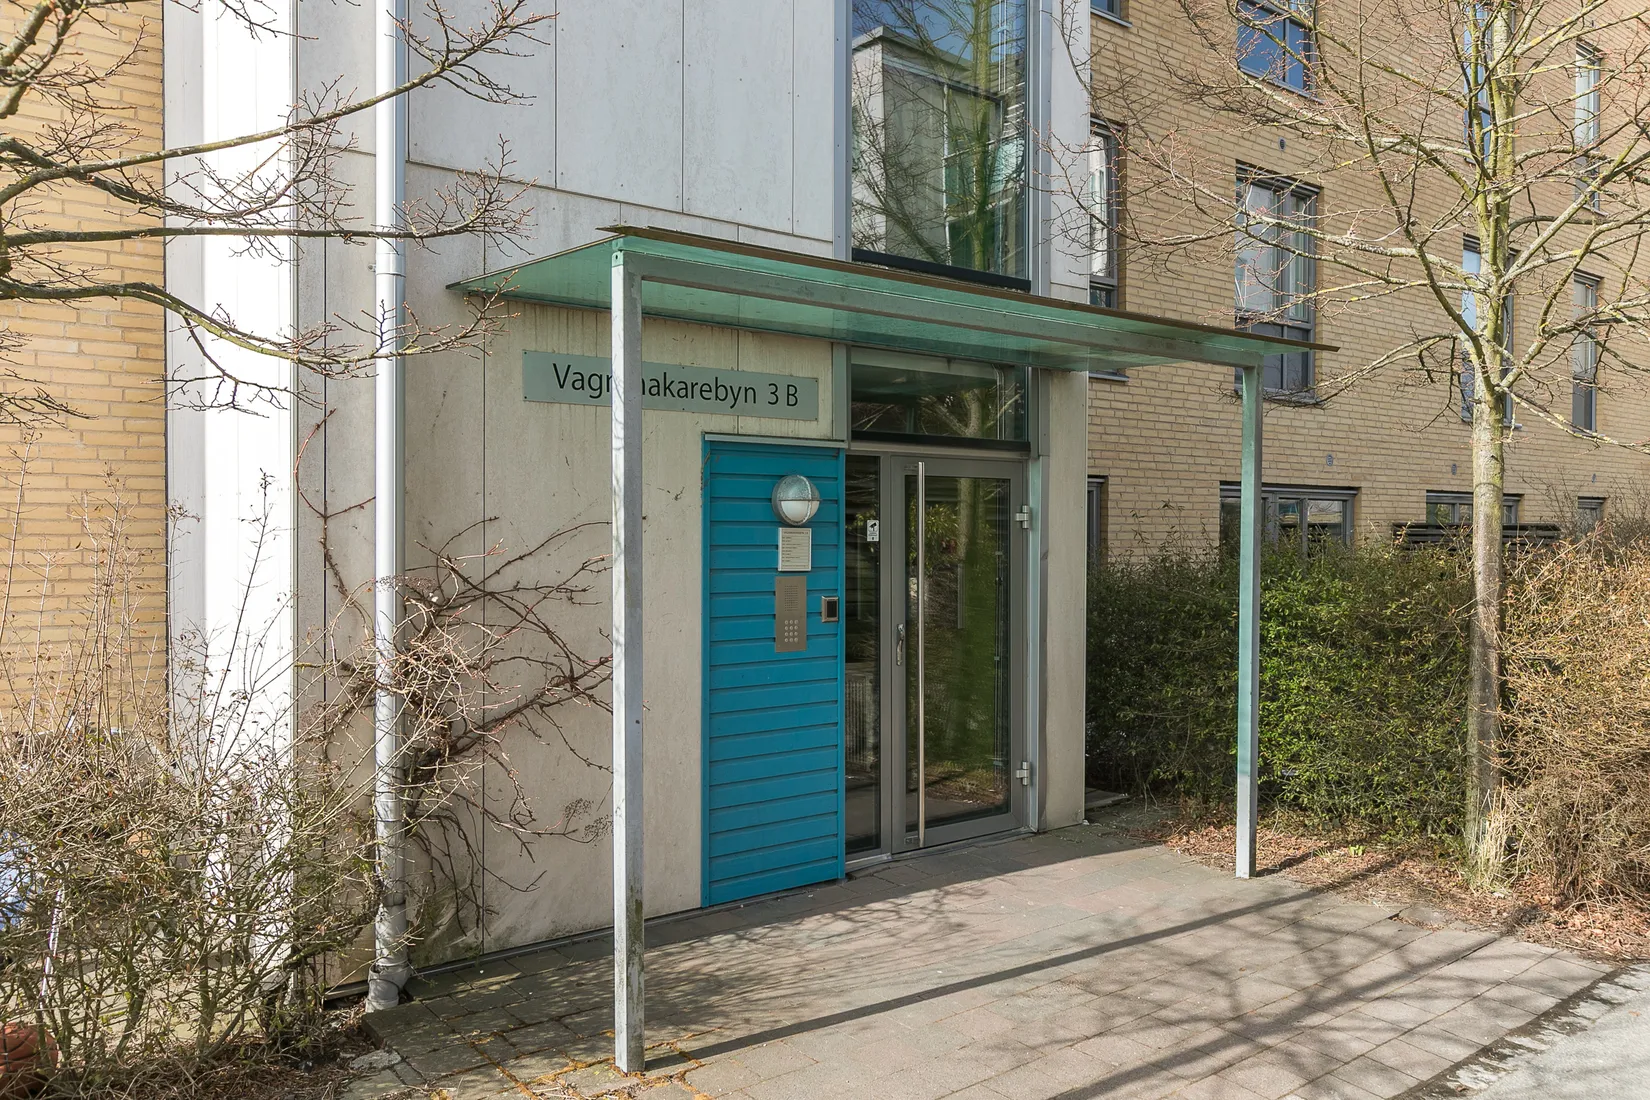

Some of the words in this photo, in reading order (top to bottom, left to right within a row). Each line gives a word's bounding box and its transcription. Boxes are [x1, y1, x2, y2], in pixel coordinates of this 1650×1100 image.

[552, 363, 756, 409] Vagakarebyn
[768, 383, 779, 405] 3
[786, 384, 798, 407] B
